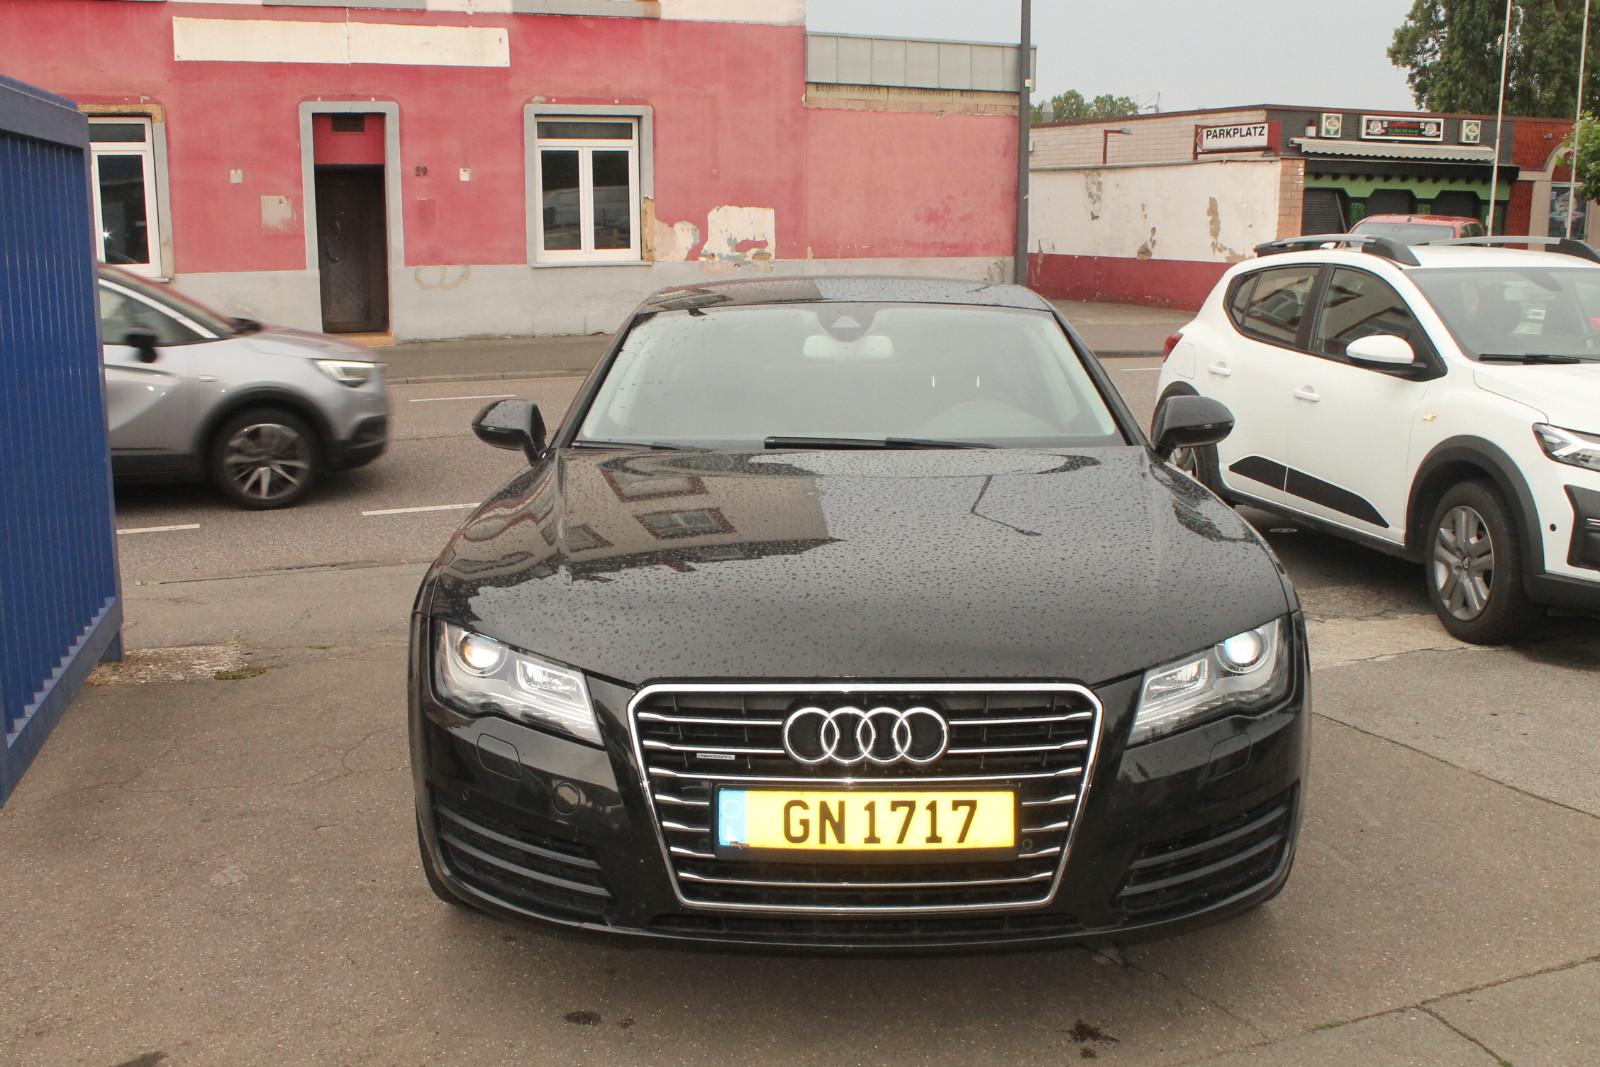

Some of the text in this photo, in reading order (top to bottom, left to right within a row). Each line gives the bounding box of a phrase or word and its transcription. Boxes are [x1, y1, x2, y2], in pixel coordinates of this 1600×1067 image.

[1206, 126, 1265, 139] PARKPLATZ
[783, 800, 977, 844] GN 1717
